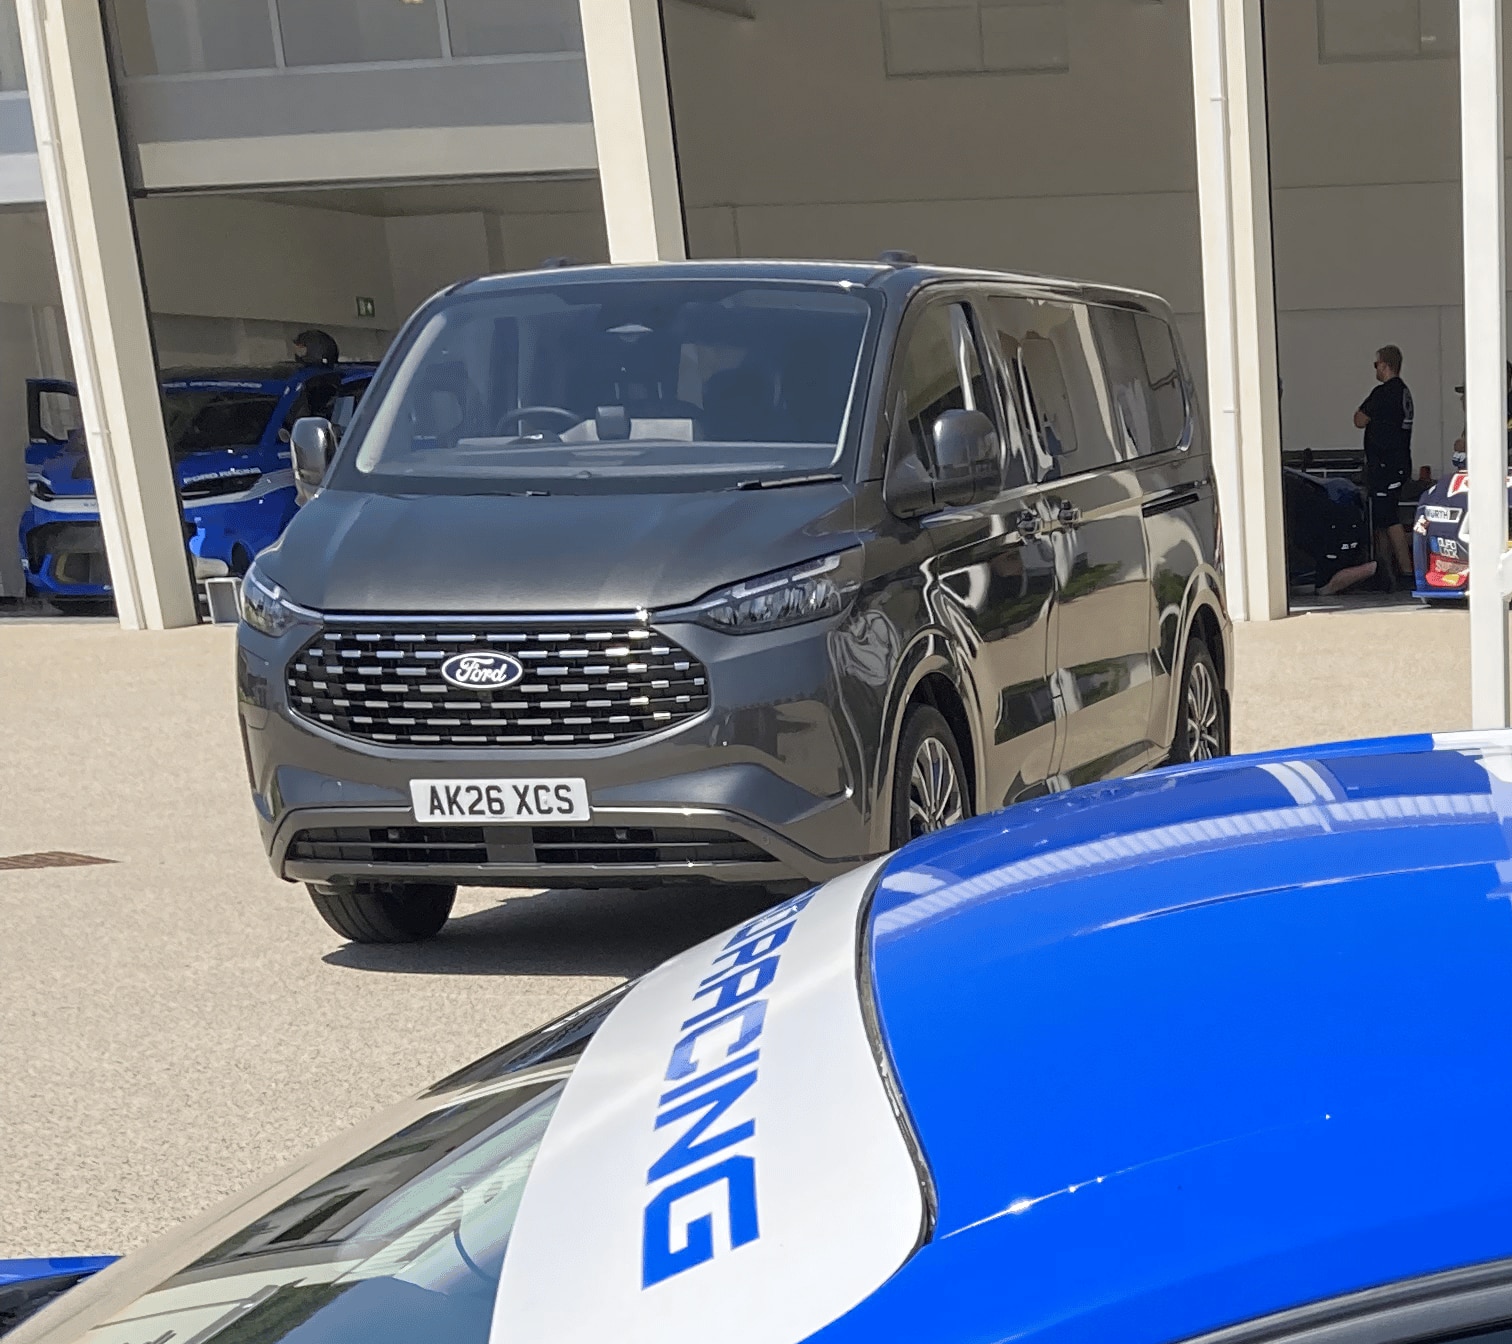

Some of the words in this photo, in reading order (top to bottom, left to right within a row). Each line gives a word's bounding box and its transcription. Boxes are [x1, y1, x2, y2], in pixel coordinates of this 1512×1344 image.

[456, 657, 507, 682] Ford
[429, 785, 505, 816] AK26
[512, 784, 575, 815] XCS
[642, 919, 797, 1291] RACING
